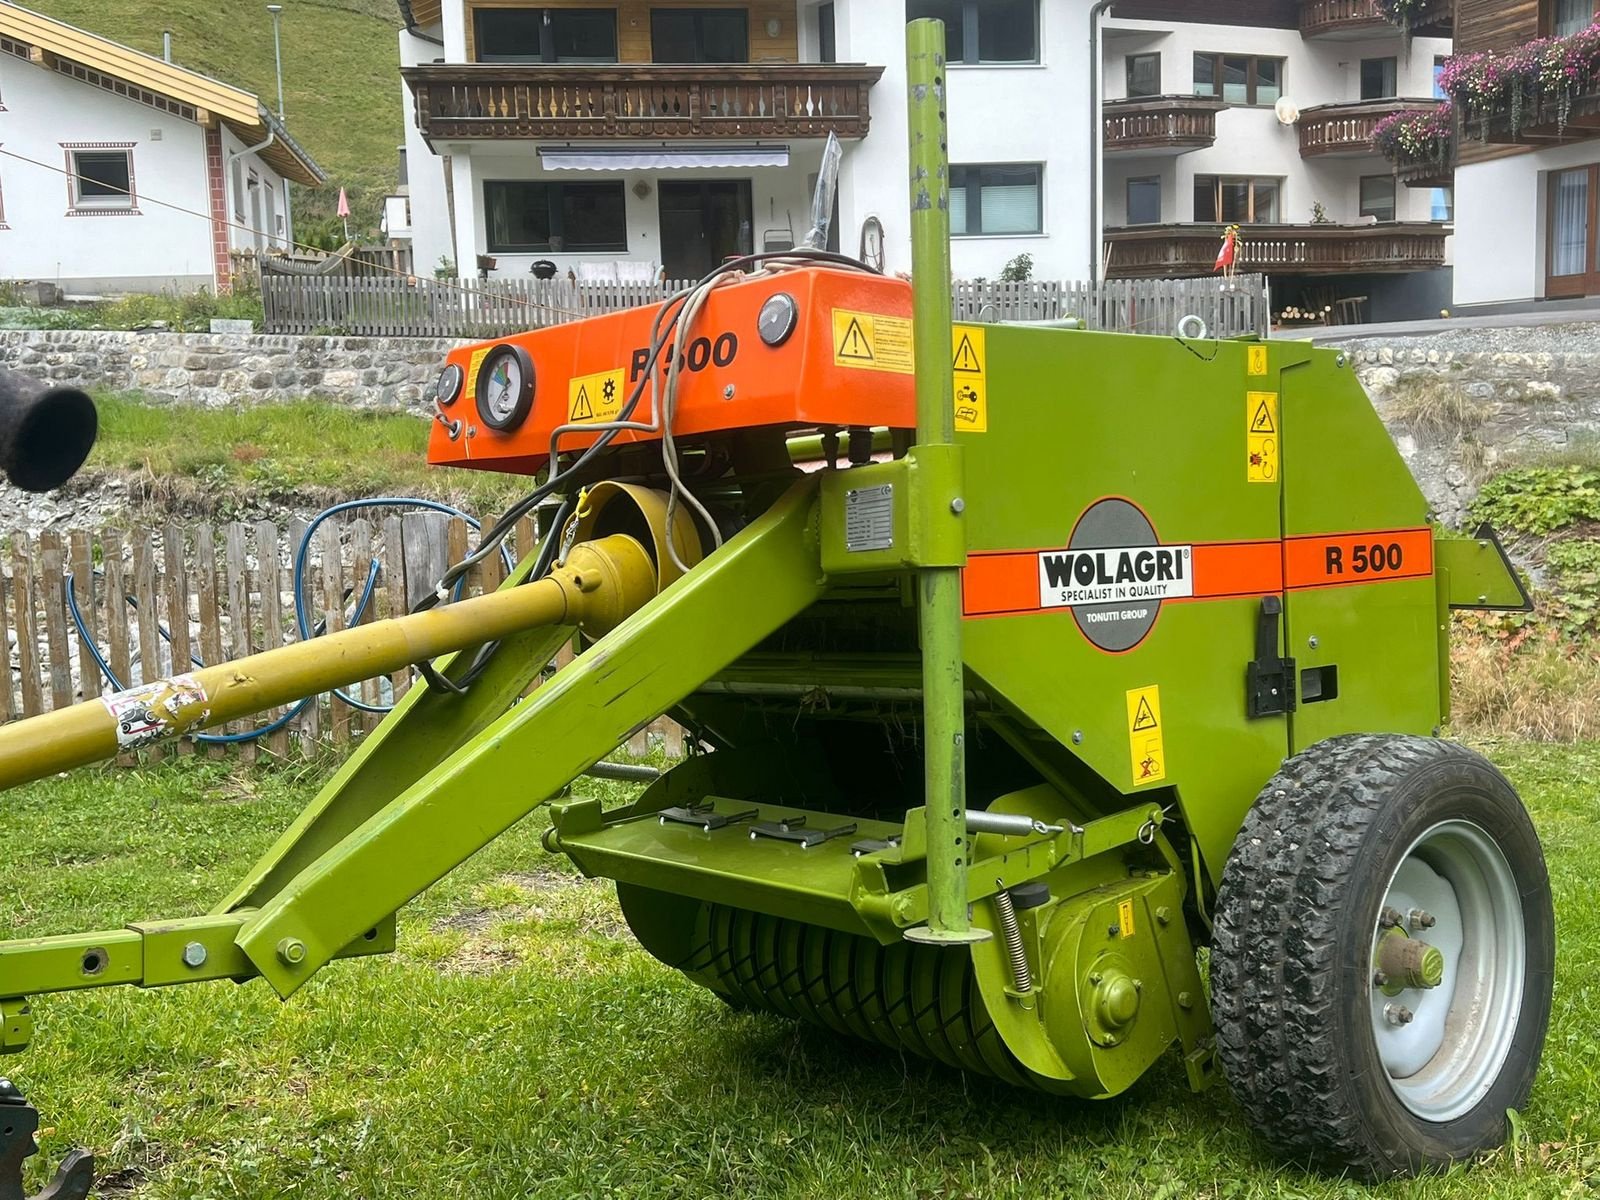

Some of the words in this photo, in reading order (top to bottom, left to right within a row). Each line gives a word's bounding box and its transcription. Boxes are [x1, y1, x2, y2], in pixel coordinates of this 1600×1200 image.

[630, 348, 652, 382] R
[663, 332, 738, 377] 500
[1326, 546, 1343, 575] R
[1352, 543, 1403, 573] 500
[1061, 588, 1112, 602] SPECIALIST
[1115, 587, 1126, 598] IN
[1130, 584, 1168, 597] QUALITY
[1086, 611, 1120, 623] TONUTTI
[1120, 608, 1148, 621] GROUP
